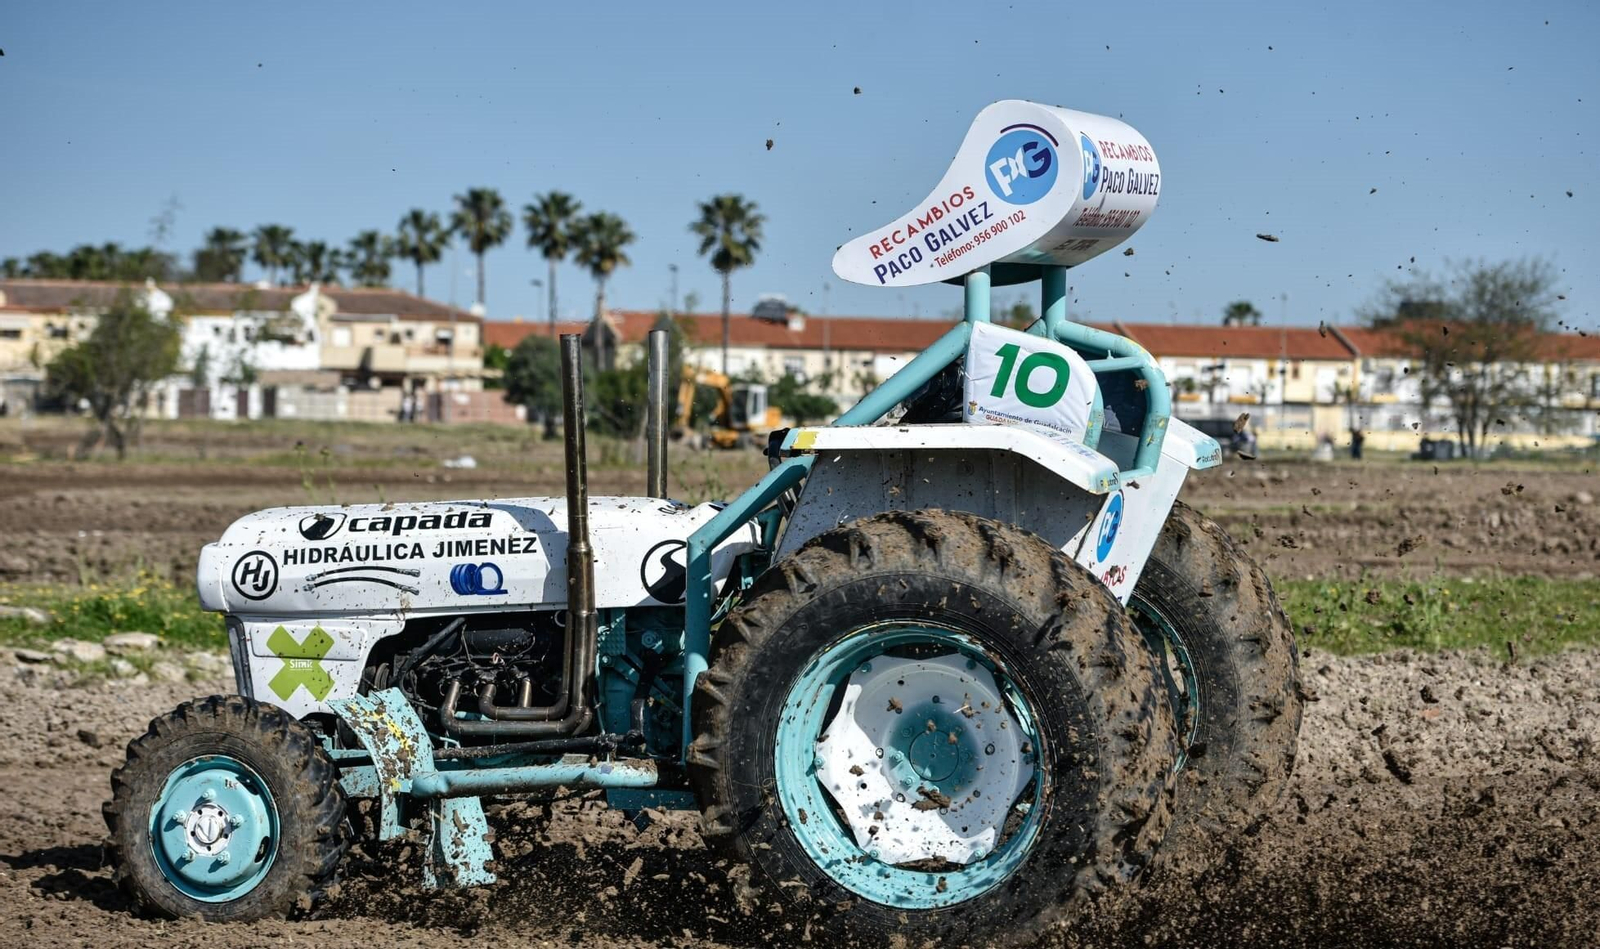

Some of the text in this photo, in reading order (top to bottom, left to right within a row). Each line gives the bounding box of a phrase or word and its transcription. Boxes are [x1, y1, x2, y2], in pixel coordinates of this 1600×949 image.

[1098, 140, 1153, 162] RECAMBIOS
[1100, 166, 1160, 196] PACO GALVEZ
[869, 186, 975, 260] RECAMBIOS
[934, 210, 1026, 268] Teléfono: 956 900 102
[873, 201, 994, 285] PACO GALVEZ
[990, 343, 1071, 408] 10
[979, 406, 1023, 421] Ayuntamiento
[348, 511, 492, 536] capada
[283, 537, 537, 566] HIDRÁULICA JIMENEZ
[240, 557, 270, 592] HJ
